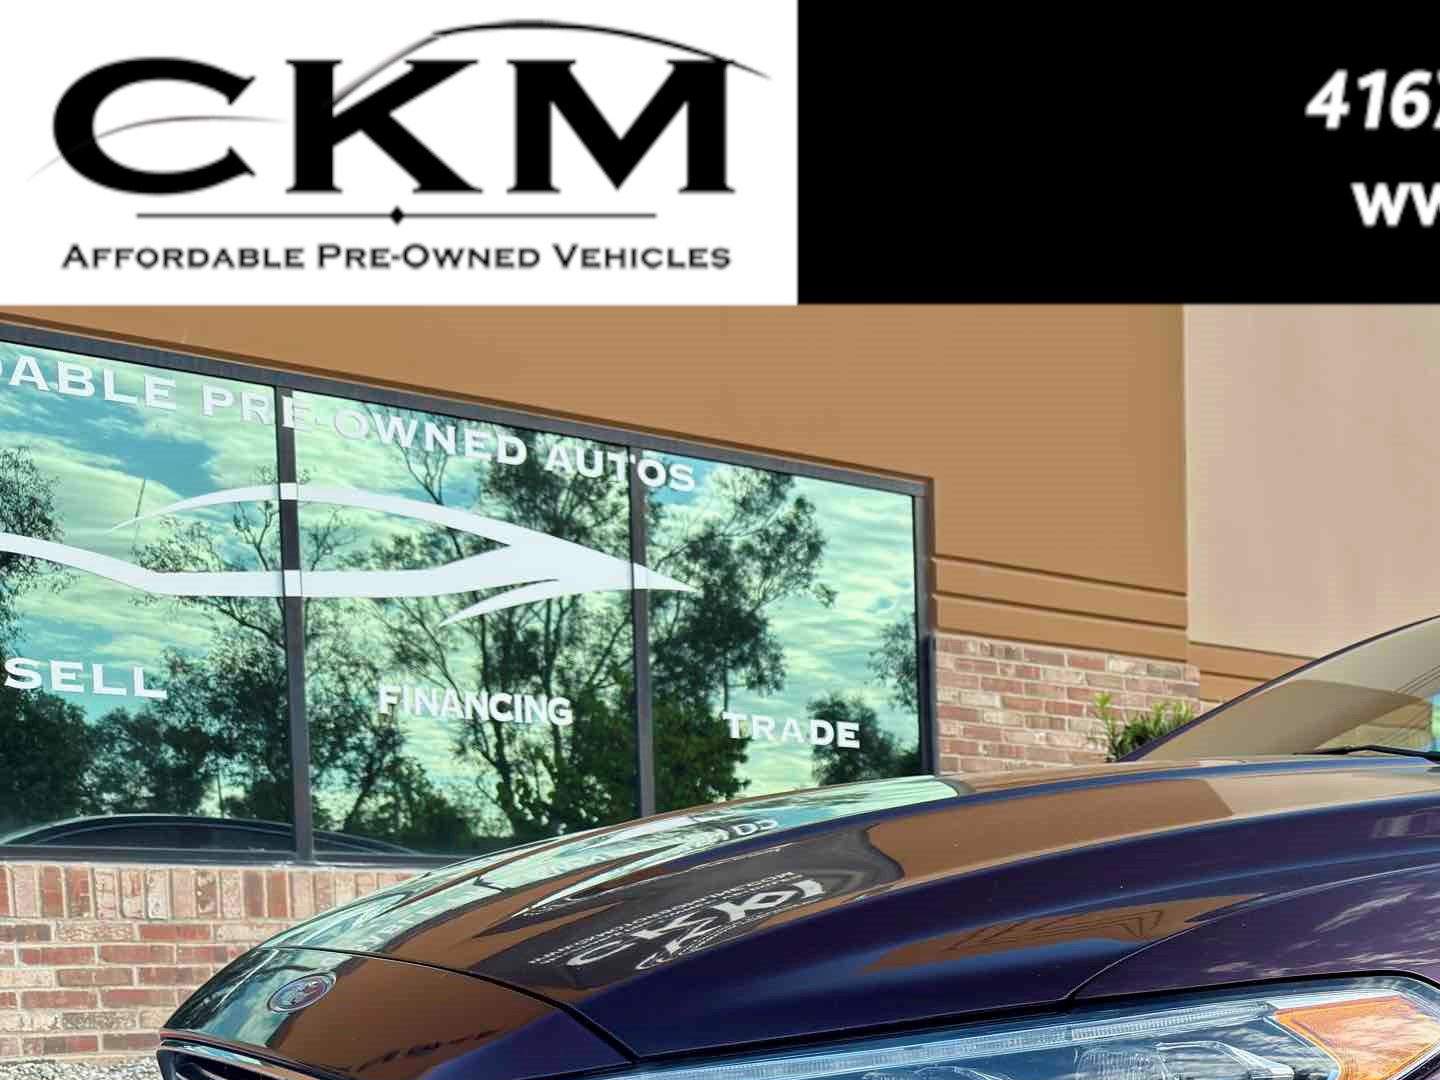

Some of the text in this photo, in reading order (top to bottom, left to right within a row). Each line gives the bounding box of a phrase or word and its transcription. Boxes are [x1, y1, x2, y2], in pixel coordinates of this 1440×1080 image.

[0, 355, 178, 411] ABLE
[545, 446, 696, 492] AUTOS
[4, 656, 168, 700] SELL
[378, 684, 574, 727] FINANCING
[722, 711, 862, 749] TRADE
